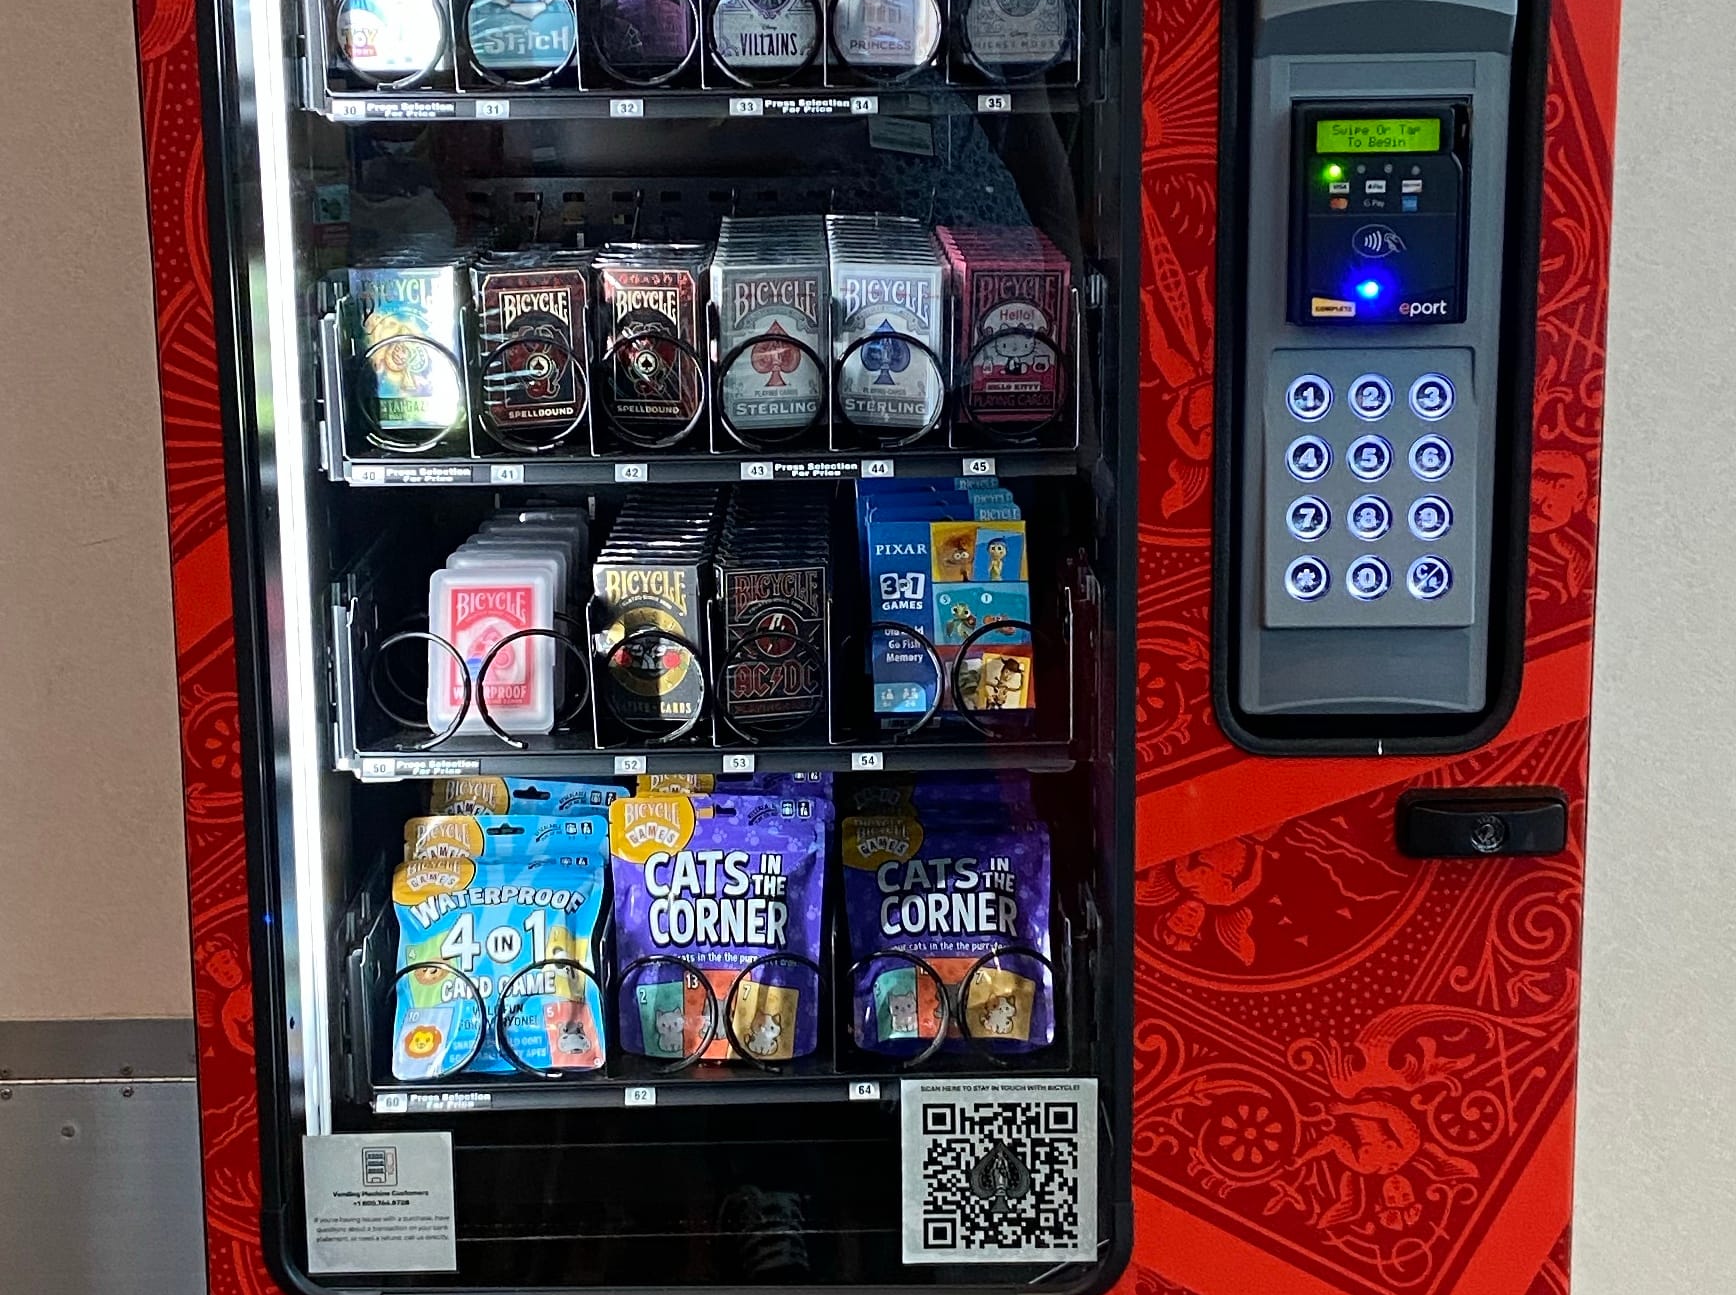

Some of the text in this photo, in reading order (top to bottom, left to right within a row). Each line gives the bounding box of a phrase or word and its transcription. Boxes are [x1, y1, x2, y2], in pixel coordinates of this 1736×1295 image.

[740, 32, 798, 56] VILLAINS
[850, 39, 912, 51] PRINCESS
[487, 104, 499, 114] 31
[621, 103, 634, 113] 32
[741, 102, 754, 111] 33
[765, 99, 850, 107] Press Selection
[855, 101, 869, 110] 34
[987, 97, 1002, 109] 35
[1332, 124, 1420, 136] Swipe Or Tap
[1349, 137, 1406, 148] To Begin
[734, 281, 817, 328] BICYCLE
[845, 278, 929, 326] BICYCLE
[980, 276, 1055, 321] BICYCLE
[503, 291, 569, 328] BICYCLE
[615, 290, 677, 324] BICYCLE
[1399, 300, 1447, 317] eport
[1301, 387, 1440, 407] 1 2 3
[508, 406, 574, 419] SPELLBOUND
[616, 405, 681, 415] SPELLBOUND
[736, 402, 817, 416] STERLING
[845, 398, 925, 414] STERLING
[1300, 448, 1439, 467] 4 5 6
[624, 467, 638, 478] 42
[751, 466, 764, 475] 43
[775, 463, 805, 471] Press
[871, 464, 885, 473] 44
[972, 460, 986, 472] 45
[501, 470, 513, 479] 41
[1299, 507, 1439, 527] 7 8 9
[876, 544, 927, 556] PIXAR
[605, 570, 688, 616] BICYCLE
[735, 571, 819, 622] BICYCLE
[456, 592, 526, 625] BICYCLE
[882, 600, 923, 611] GAMES
[888, 639, 921, 649] Go Fish
[886, 653, 924, 664] Memory
[661, 702, 691, 713] CARDS
[624, 758, 637, 769] 52
[732, 757, 746, 768] 53
[861, 755, 875, 766] 54
[624, 802, 680, 829] BICYCLE
[627, 825, 679, 847] GAMES
[860, 838, 910, 854] GAMES
[761, 854, 782, 874] IN
[990, 858, 1009, 871] IN
[645, 851, 748, 897] CATS
[878, 858, 979, 893] CATS
[751, 875, 787, 896] THE
[982, 872, 1015, 892] THE
[410, 887, 586, 930] WATERPROOF
[881, 892, 1017, 937] CORNER
[650, 899, 787, 945] CORNER
[440, 909, 547, 972] 4 IN 1
[686, 974, 699, 988] 13
[634, 1090, 647, 1101] 62
[858, 1085, 871, 1095] 64
